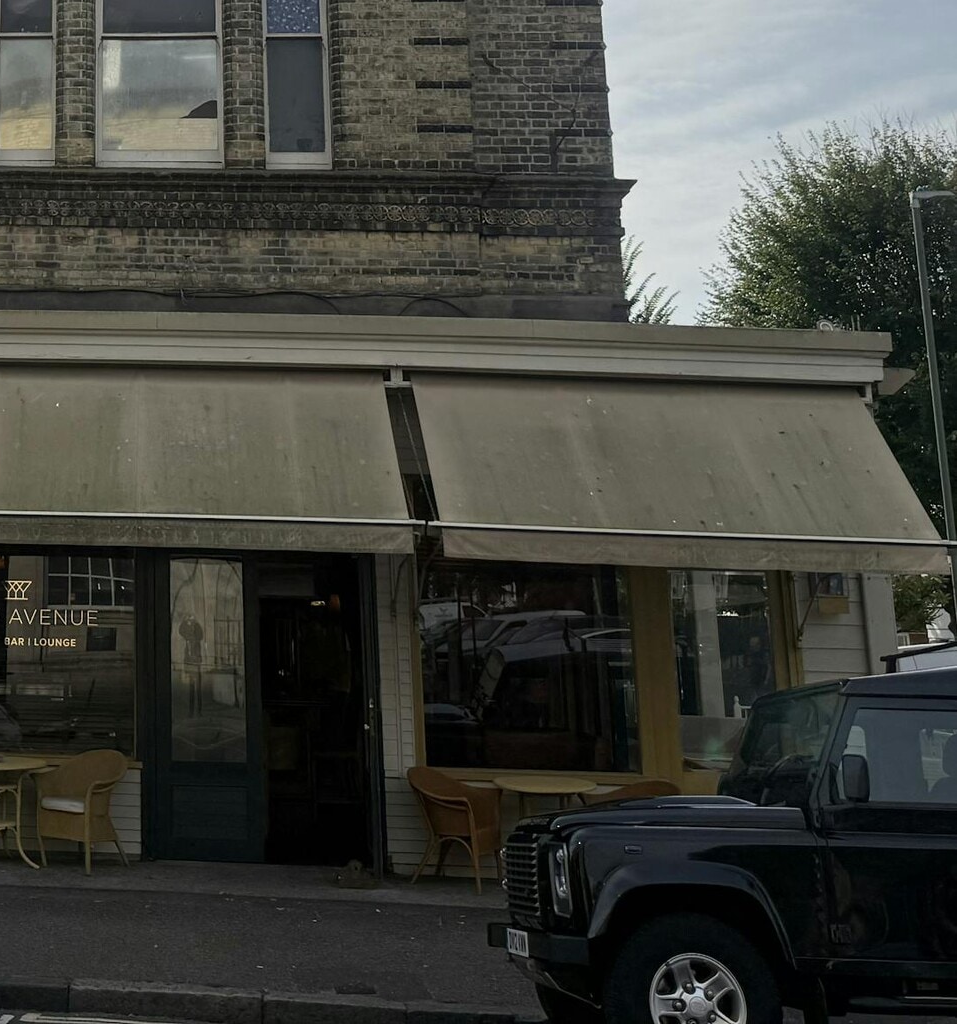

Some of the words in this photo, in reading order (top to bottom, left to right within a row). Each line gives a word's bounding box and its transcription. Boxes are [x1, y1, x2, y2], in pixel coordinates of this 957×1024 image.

[8, 608, 100, 627] AVENUE
[4, 637, 25, 647] BAR
[33, 637, 77, 647] LOUNGE
